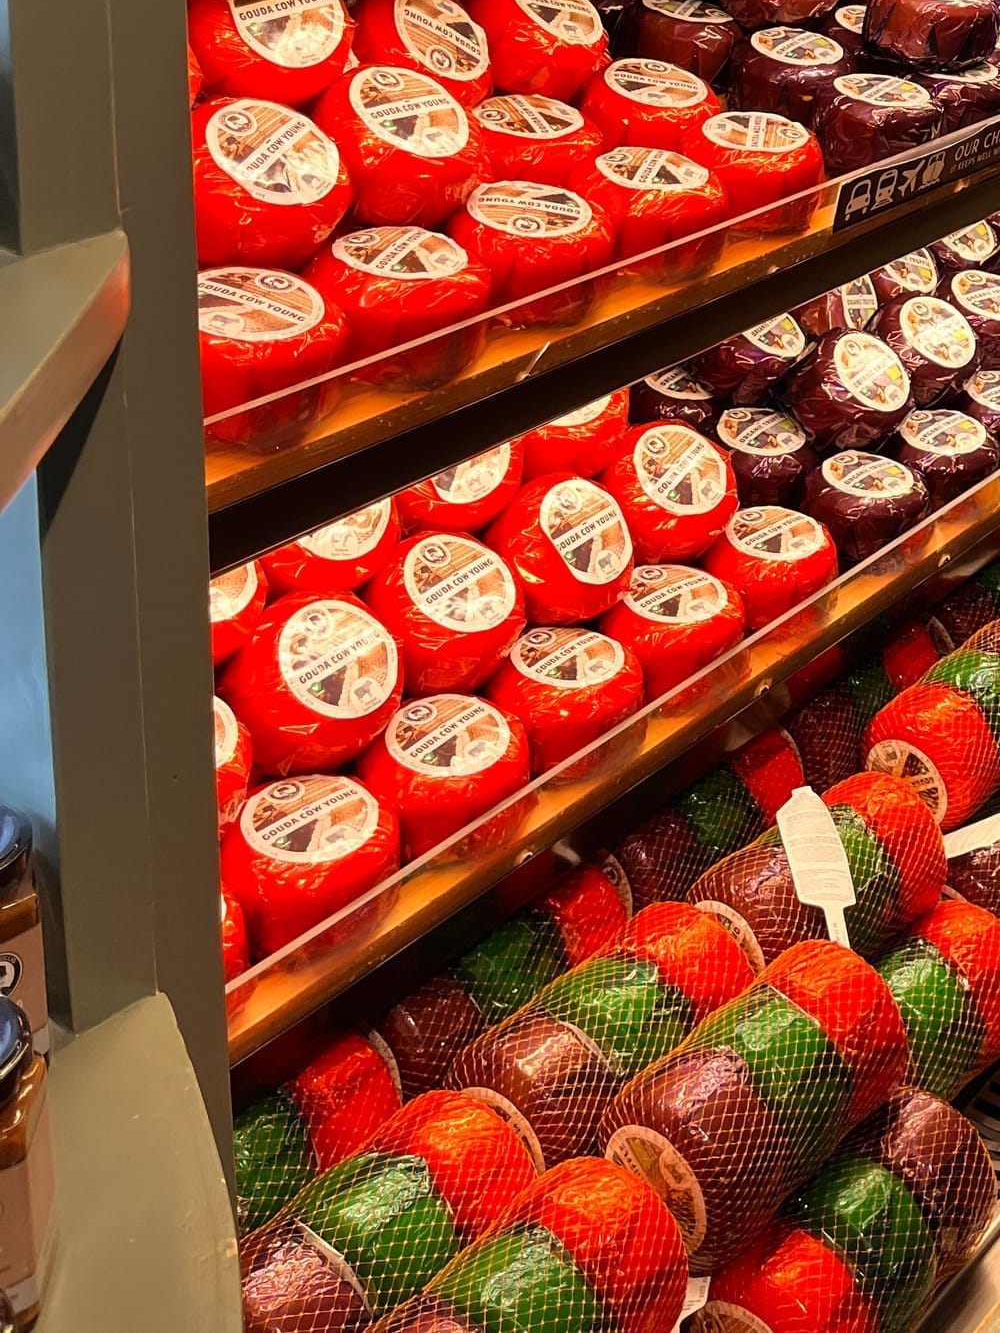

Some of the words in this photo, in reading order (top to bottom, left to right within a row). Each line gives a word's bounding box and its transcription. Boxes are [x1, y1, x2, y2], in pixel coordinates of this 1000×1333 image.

[238, 5, 274, 22] GOUDA
[404, 7, 434, 28] YOUNG
[435, 22, 454, 39] COW
[454, 34, 482, 57] GOUDA
[370, 105, 403, 120] GOUDA
[402, 101, 422, 113] COW
[421, 97, 451, 109] YOUNG
[267, 140, 286, 157] COW
[281, 120, 307, 145] YOUNG
[954, 138, 981, 162] OUR
[198, 281, 239, 297] GOUDA
[238, 293, 266, 307] COW
[265, 301, 307, 323] YOUNG
[581, 522, 597, 538] COW
[425, 582, 454, 605] GOUDA
[452, 570, 471, 588] COW
[469, 557, 495, 578] YOUNG
[640, 591, 668, 609] GOUDA
[666, 582, 685, 596] COW
[683, 575, 709, 588] YOUNG
[299, 658, 332, 685] GOUDA
[330, 644, 352, 666] COW
[535, 653, 561, 675] GOUDA
[559, 642, 578, 658] COW
[575, 633, 601, 649] YOUNG
[410, 735, 441, 759] GOUDA
[439, 722, 461, 740] COW
[458, 705, 487, 728] YOUNG
[262, 816, 300, 841] GOUDA
[300, 803, 324, 821] COW
[323, 788, 359, 811] YOUNG
